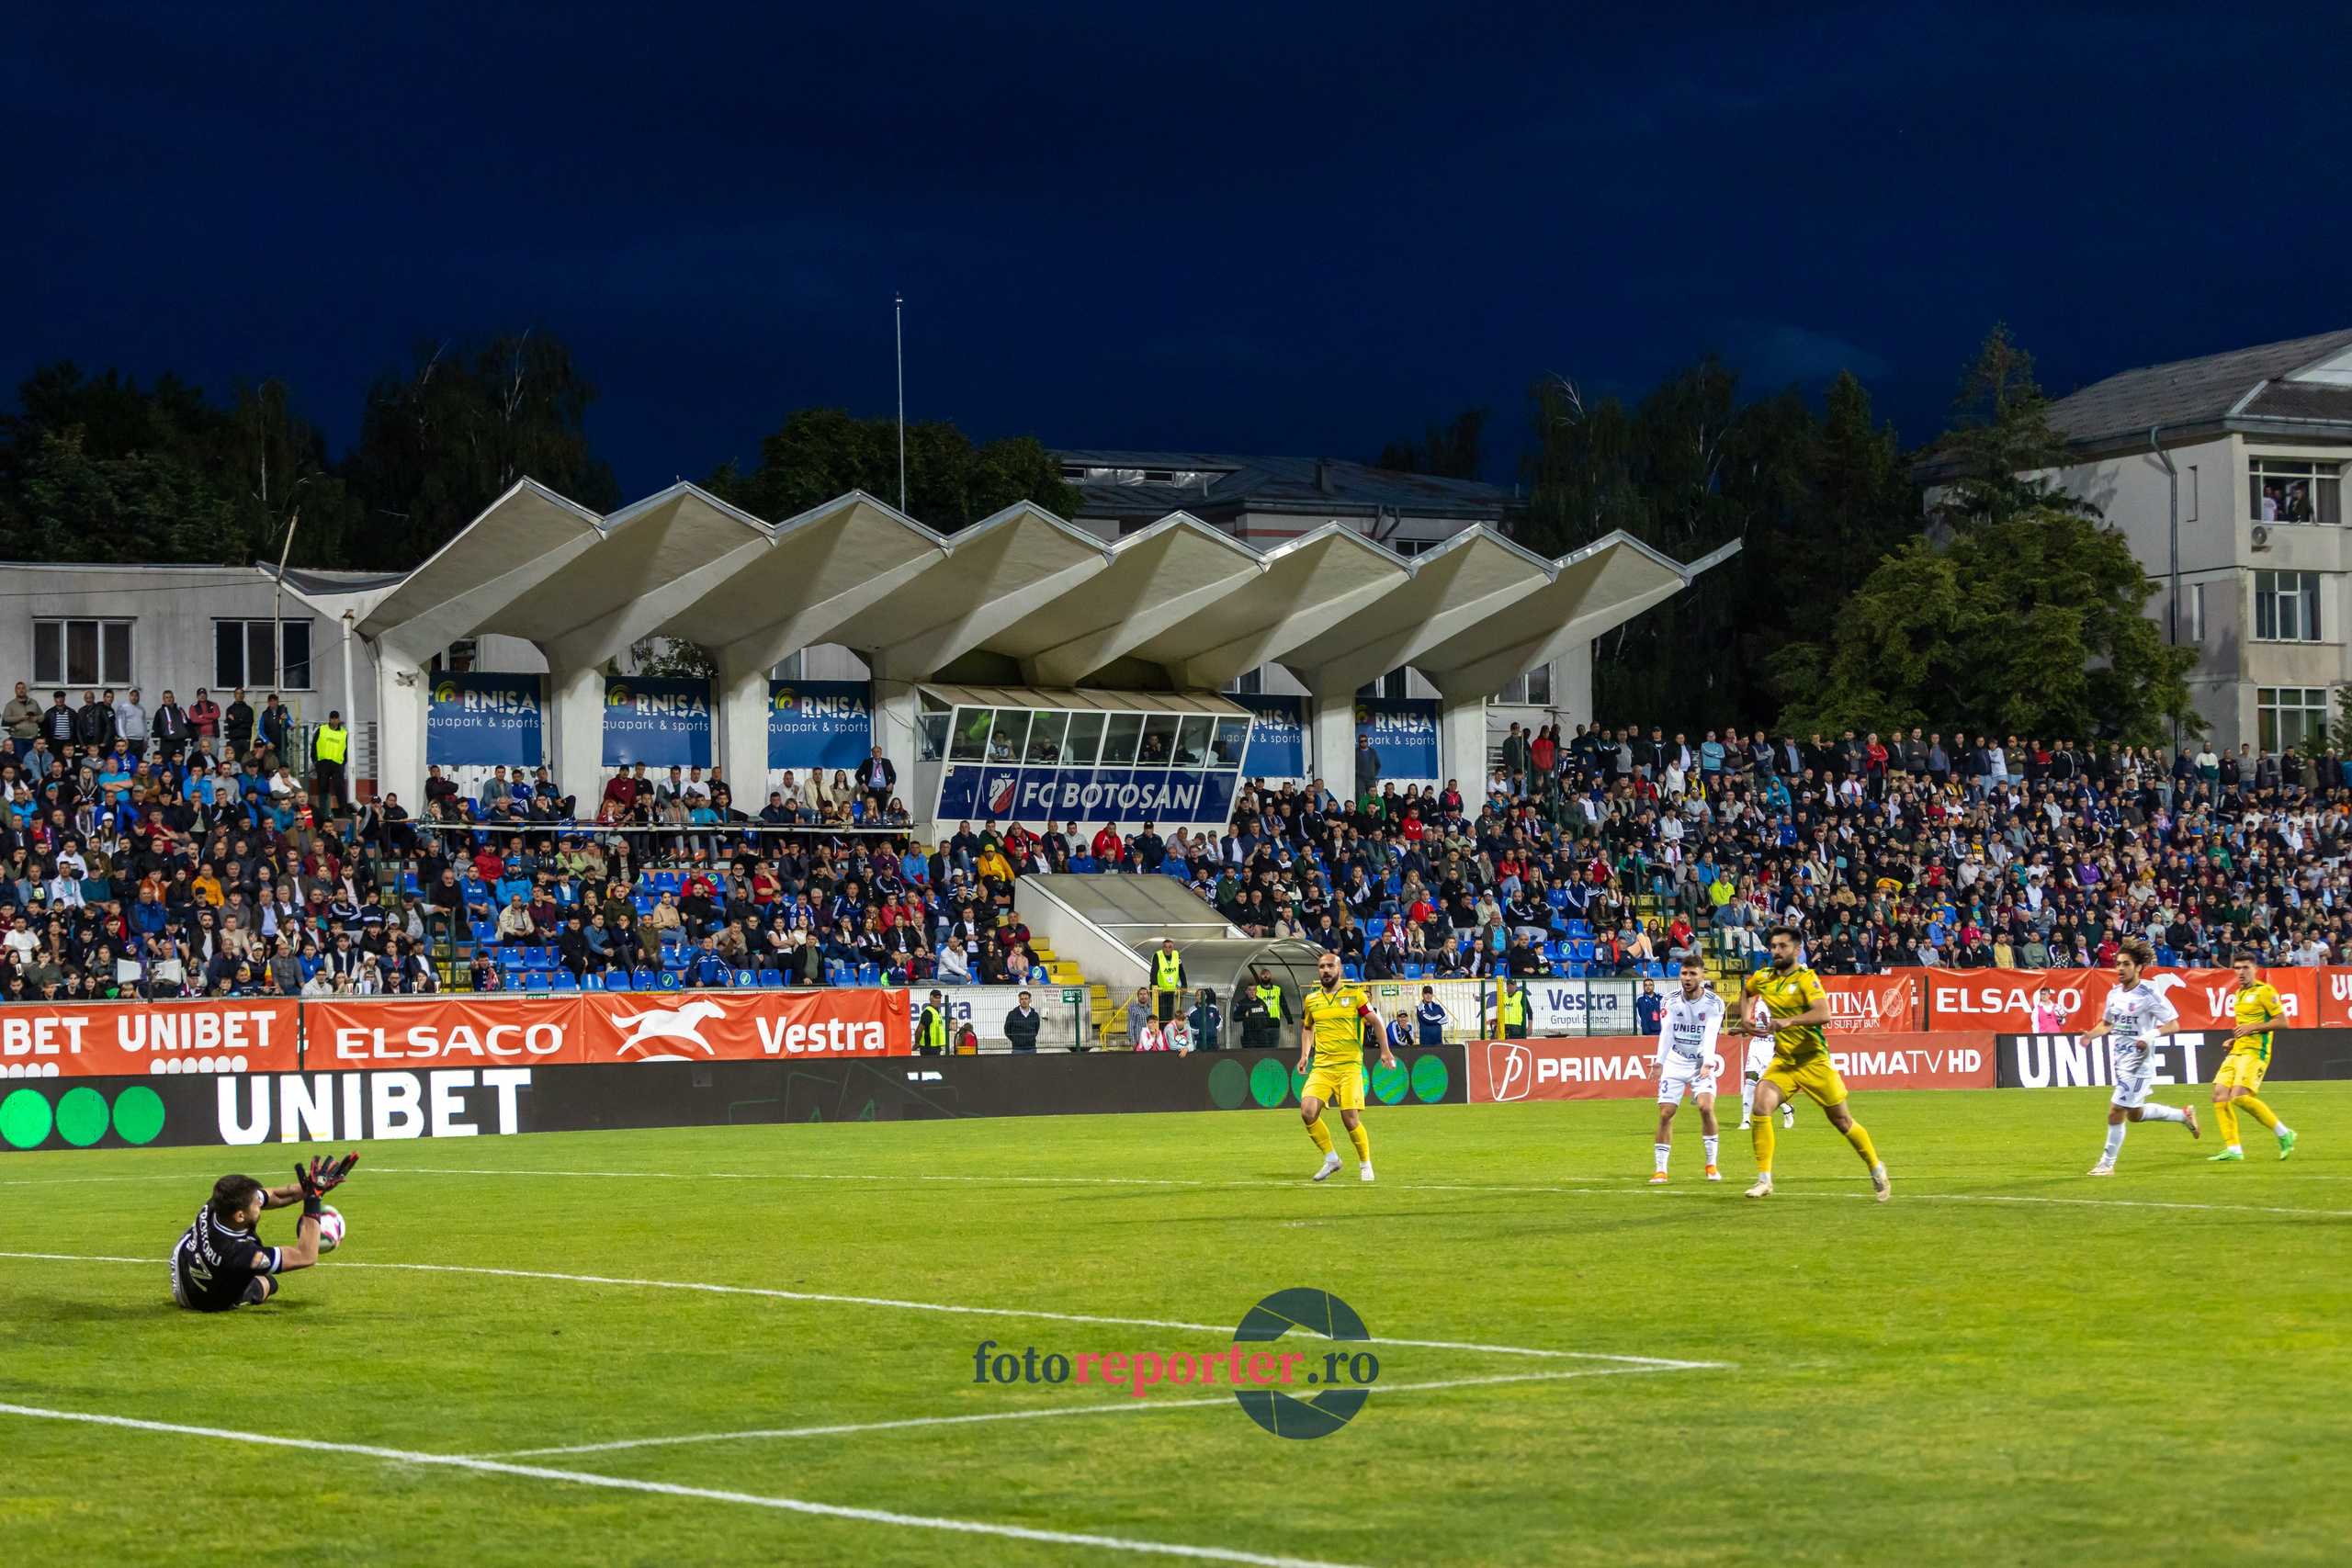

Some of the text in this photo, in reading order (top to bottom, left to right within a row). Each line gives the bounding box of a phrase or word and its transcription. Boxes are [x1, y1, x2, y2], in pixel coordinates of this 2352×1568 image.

[428, 716, 539, 729] quapark & sports
[603, 719, 708, 732] quapark & sports
[768, 721, 868, 734] quapark & sports
[1261, 733, 1267, 743] &
[1271, 734, 1301, 745] sports
[1395, 736, 1401, 745] &
[1406, 736, 1435, 747] sports
[1022, 782, 1057, 808] FC
[1053, 964, 1057, 974] 3
[1724, 983, 1727, 991] 2
[1547, 989, 1618, 1011] Vestra
[1826, 989, 1881, 1019] TINA
[2206, 987, 2299, 1017] Vea
[1551, 1014, 1610, 1028] Grupul Esaco
[1673, 1023, 1705, 1033] UNIBET
[1834, 1020, 1862, 1029] SUFLET
[1864, 1019, 1881, 1028] BUN
[3, 1017, 89, 1055] BET
[118, 1010, 277, 1052] UNIBET
[755, 1016, 885, 1054] Vestra
[336, 1024, 564, 1059] ELSACO
[1672, 1043, 1703, 1059] ELSAC
[1829, 1049, 1981, 1076] RIMATV HD
[2016, 1032, 2205, 1089] UNIET
[217, 1068, 532, 1145] UNIBET
